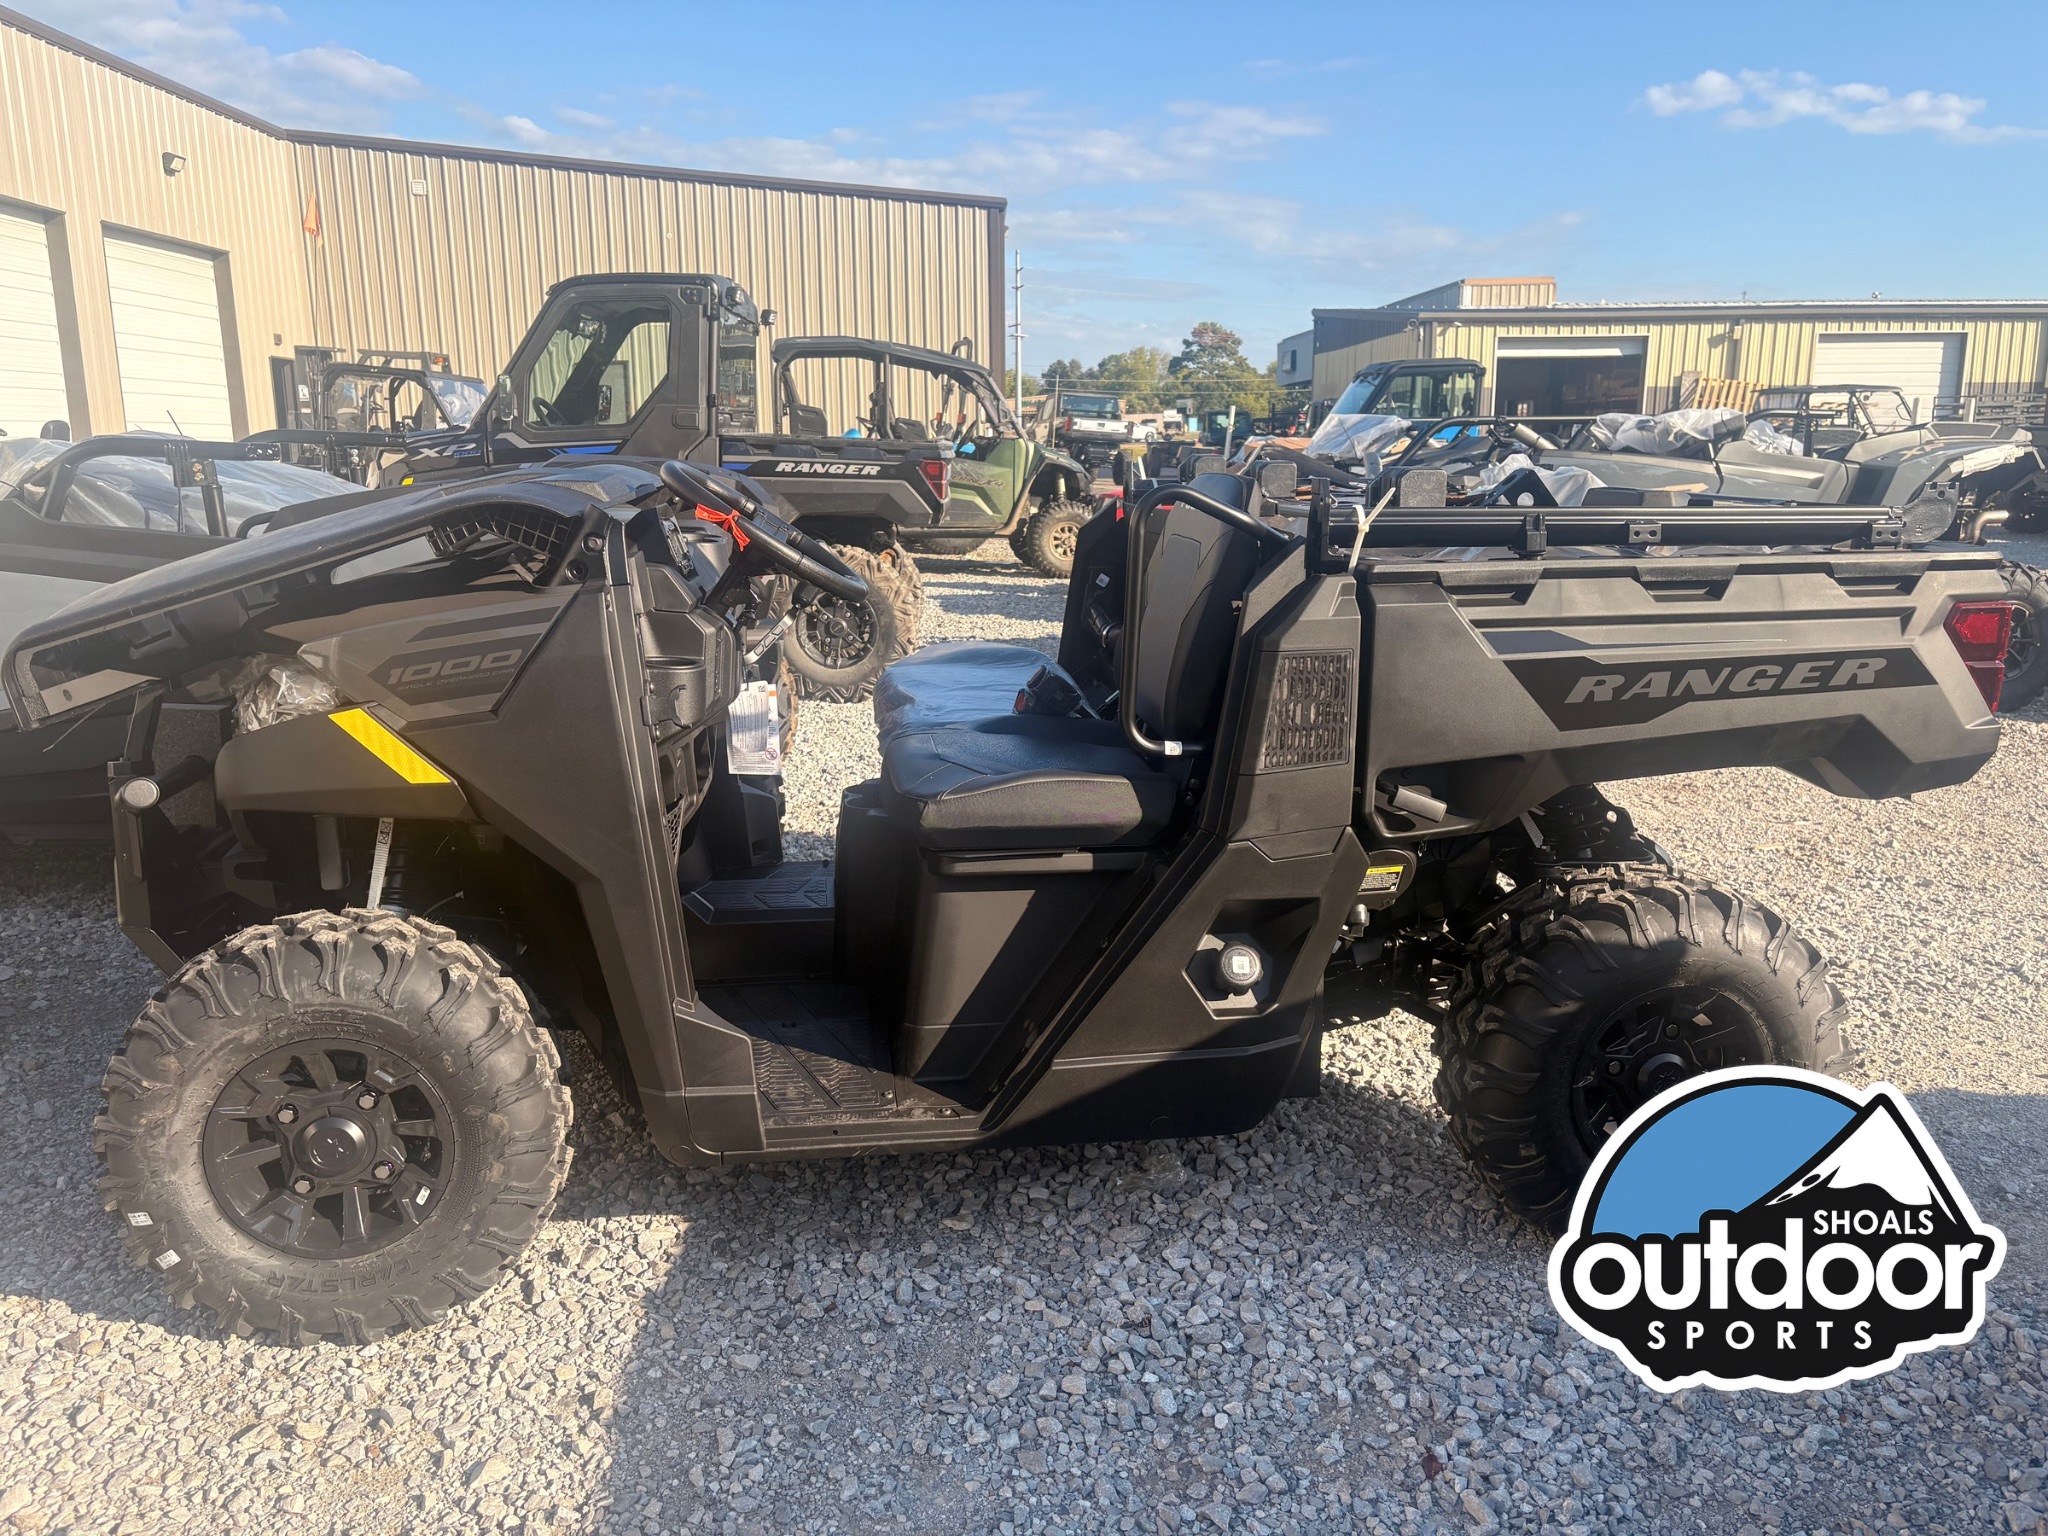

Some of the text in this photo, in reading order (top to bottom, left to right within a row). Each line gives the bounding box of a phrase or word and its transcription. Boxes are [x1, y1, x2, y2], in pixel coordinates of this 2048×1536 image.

[410, 443, 477, 461] XP
[775, 462, 881, 476] RANGER
[387, 649, 523, 685] 1000
[436, 671, 491, 685] OVERHEAD
[491, 668, 515, 676] CAM
[1563, 657, 1888, 704] RANGER
